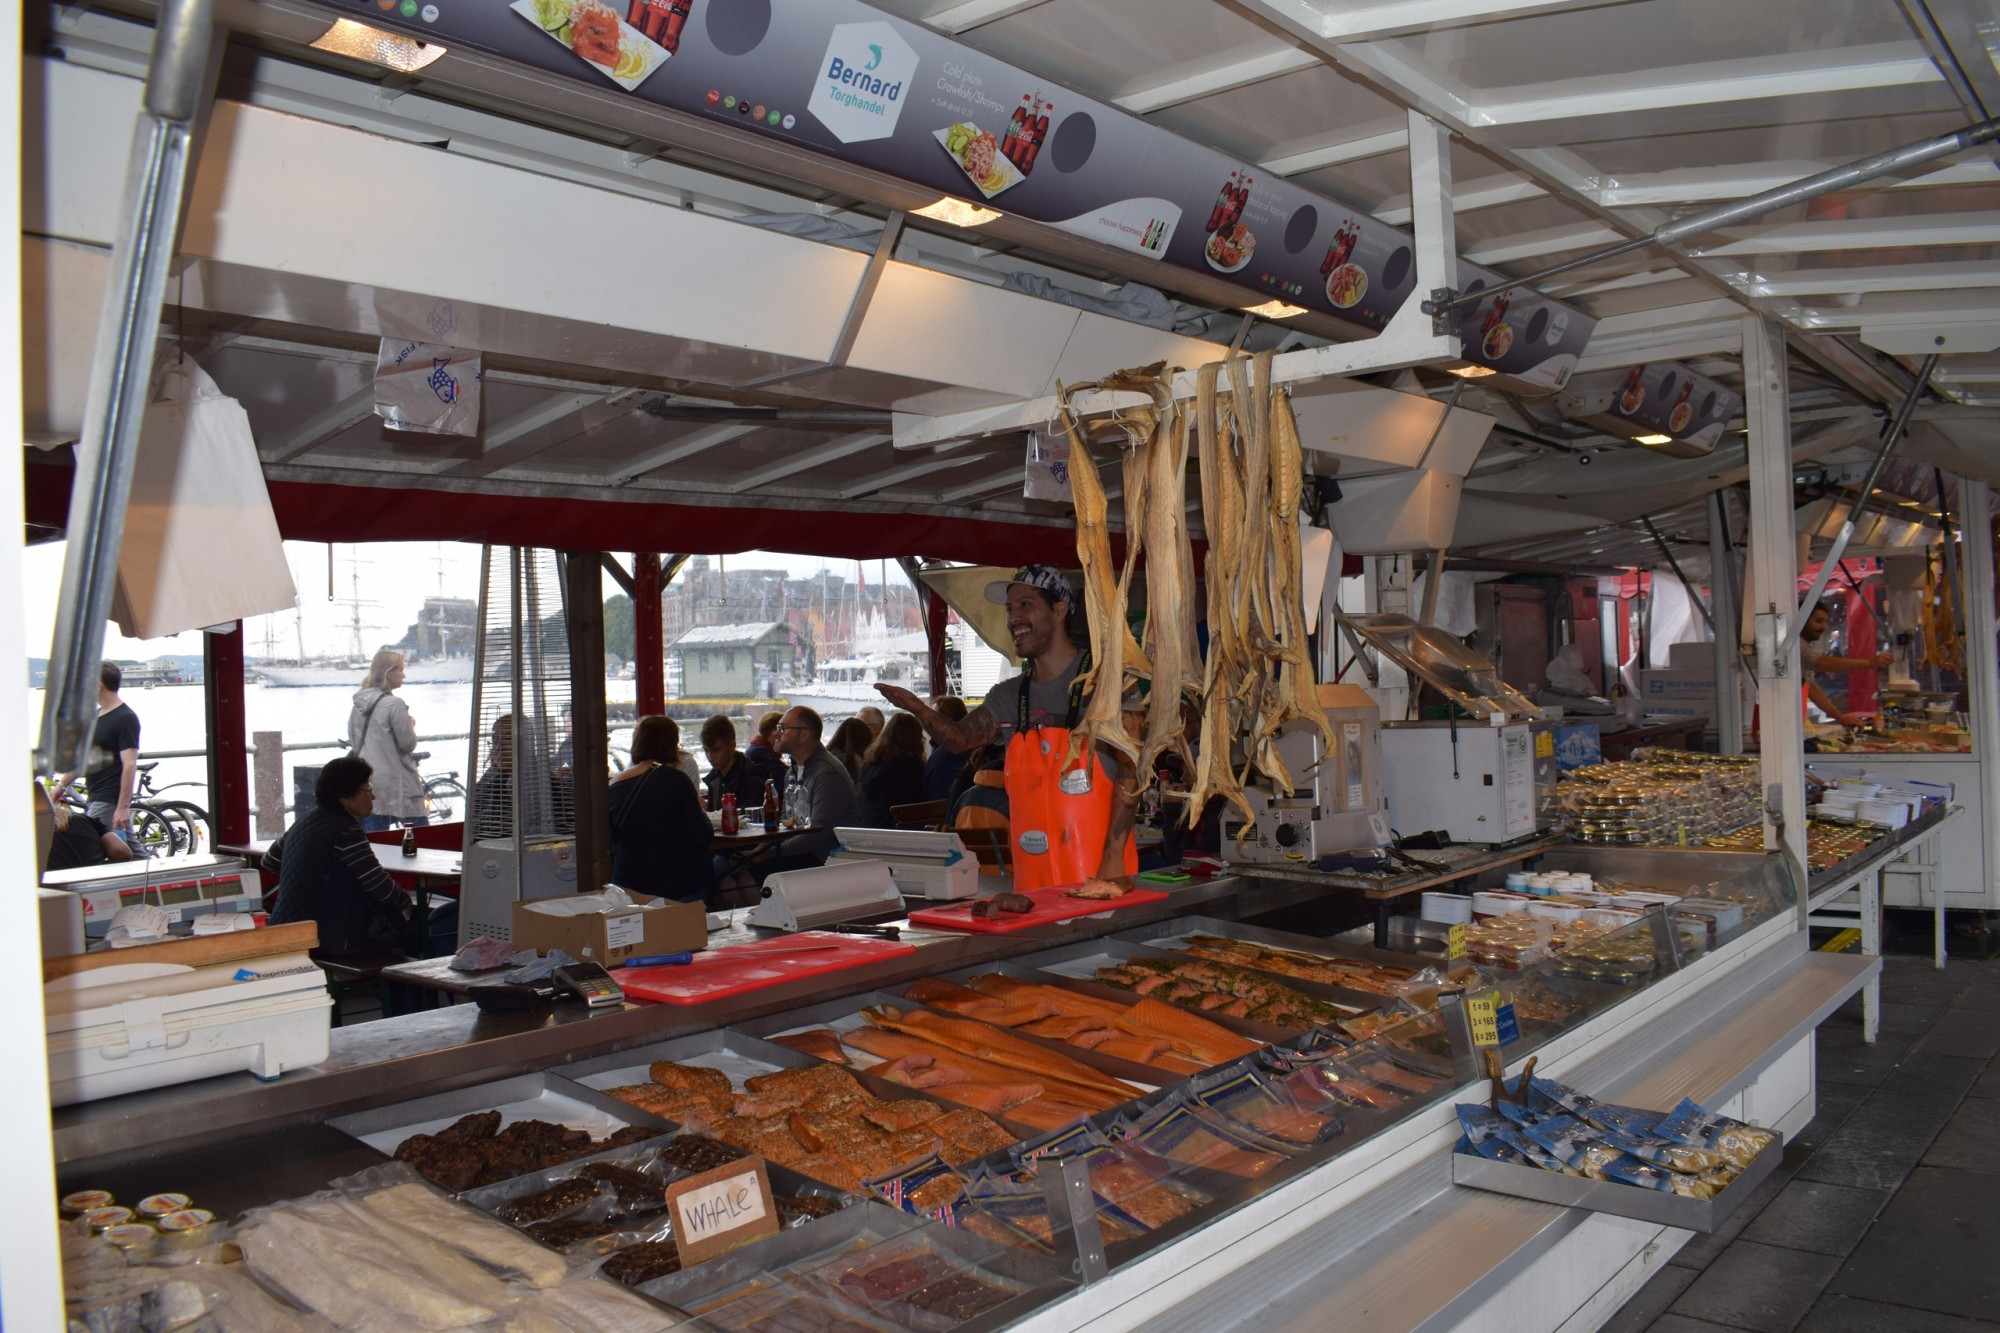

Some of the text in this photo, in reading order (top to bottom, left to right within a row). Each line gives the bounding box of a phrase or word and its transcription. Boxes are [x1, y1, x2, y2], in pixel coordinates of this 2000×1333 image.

[827, 56, 902, 101] Bernard
[942, 61, 984, 87] Cold plate
[830, 85, 886, 116] Torghandel
[1098, 217, 1118, 229] choose
[395, 342, 416, 366] FISK
[1472, 1002, 1476, 1011] 1
[1482, 1002, 1490, 1011] 59
[1472, 1017, 1478, 1027] 3
[1483, 1016, 1494, 1026] 165
[1475, 1033, 1480, 1042] 6
[1484, 1031, 1497, 1041] 295
